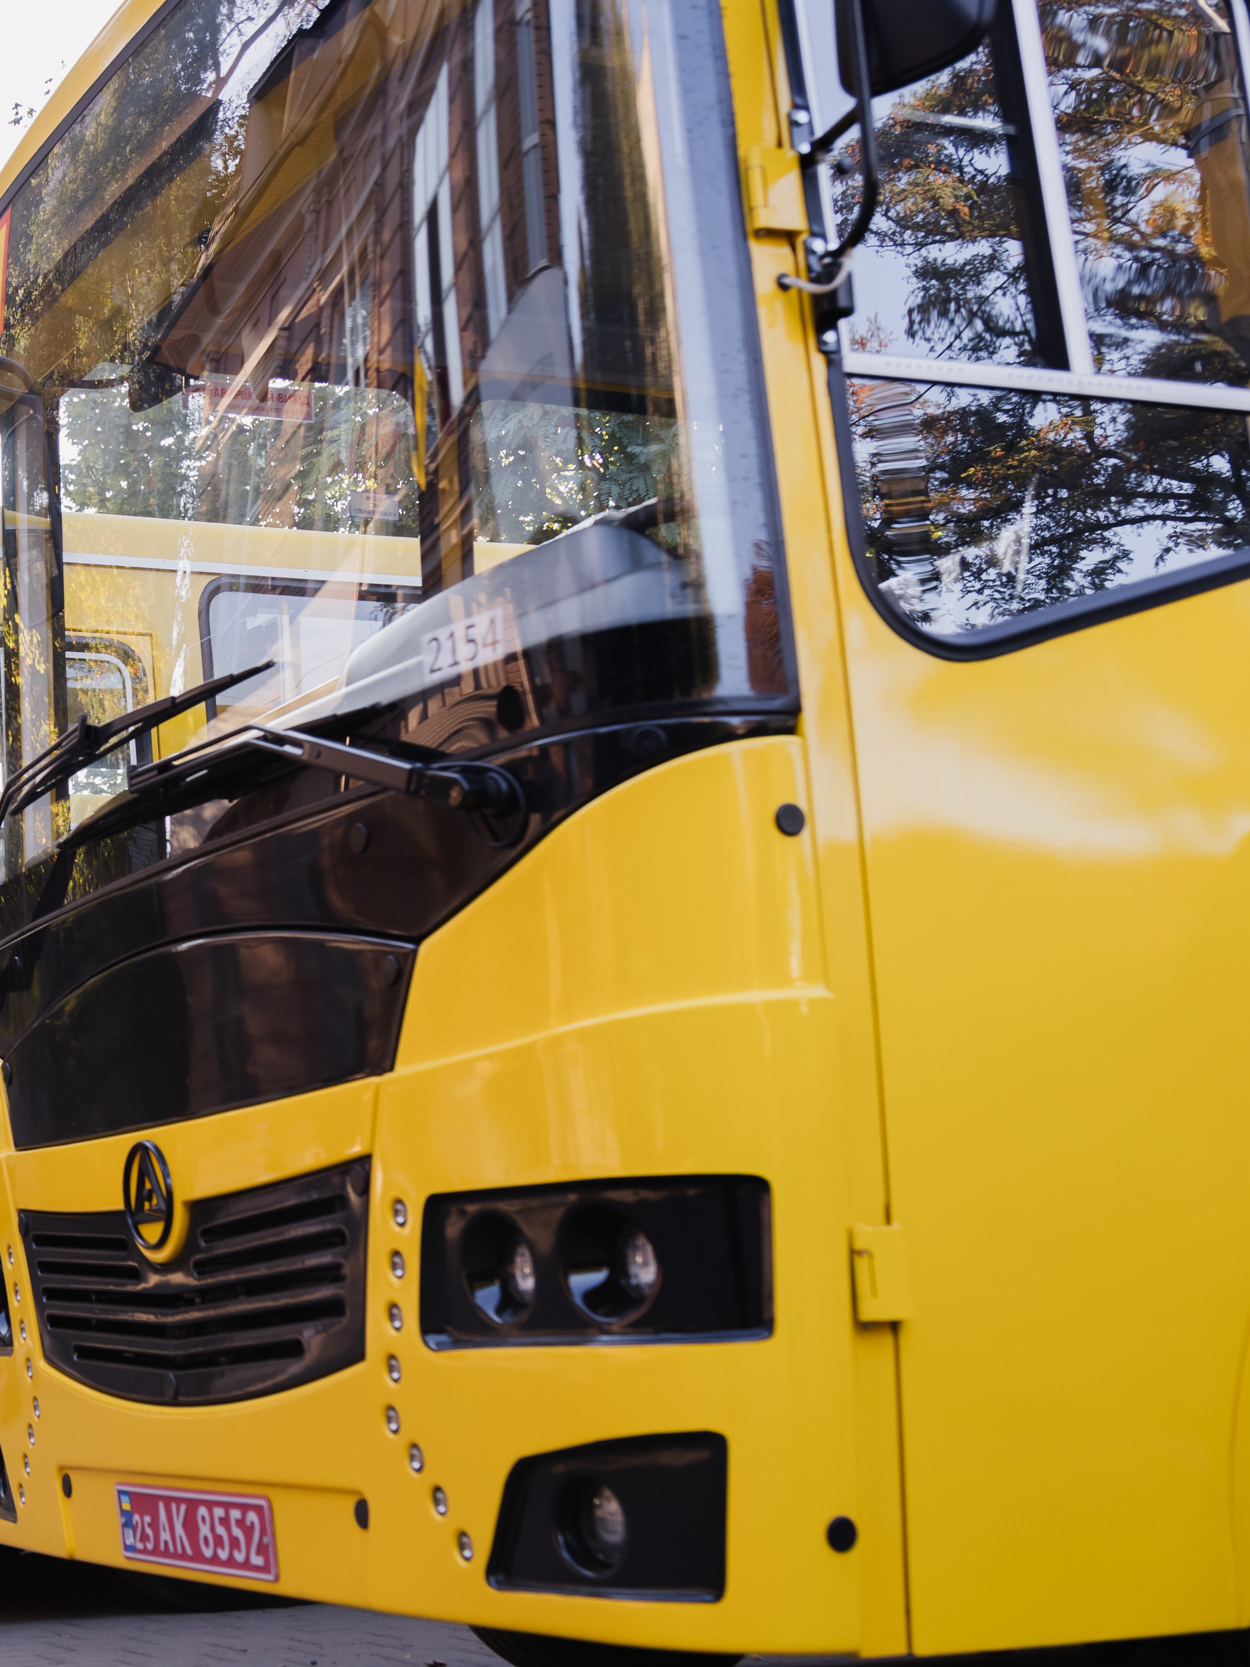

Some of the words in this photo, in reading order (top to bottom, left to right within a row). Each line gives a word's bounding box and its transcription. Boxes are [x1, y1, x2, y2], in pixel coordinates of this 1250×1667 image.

[427, 617, 498, 674] 2154
[132, 1513, 155, 1552] 25
[158, 1501, 193, 1556] AK
[196, 1505, 265, 1567] 8552
